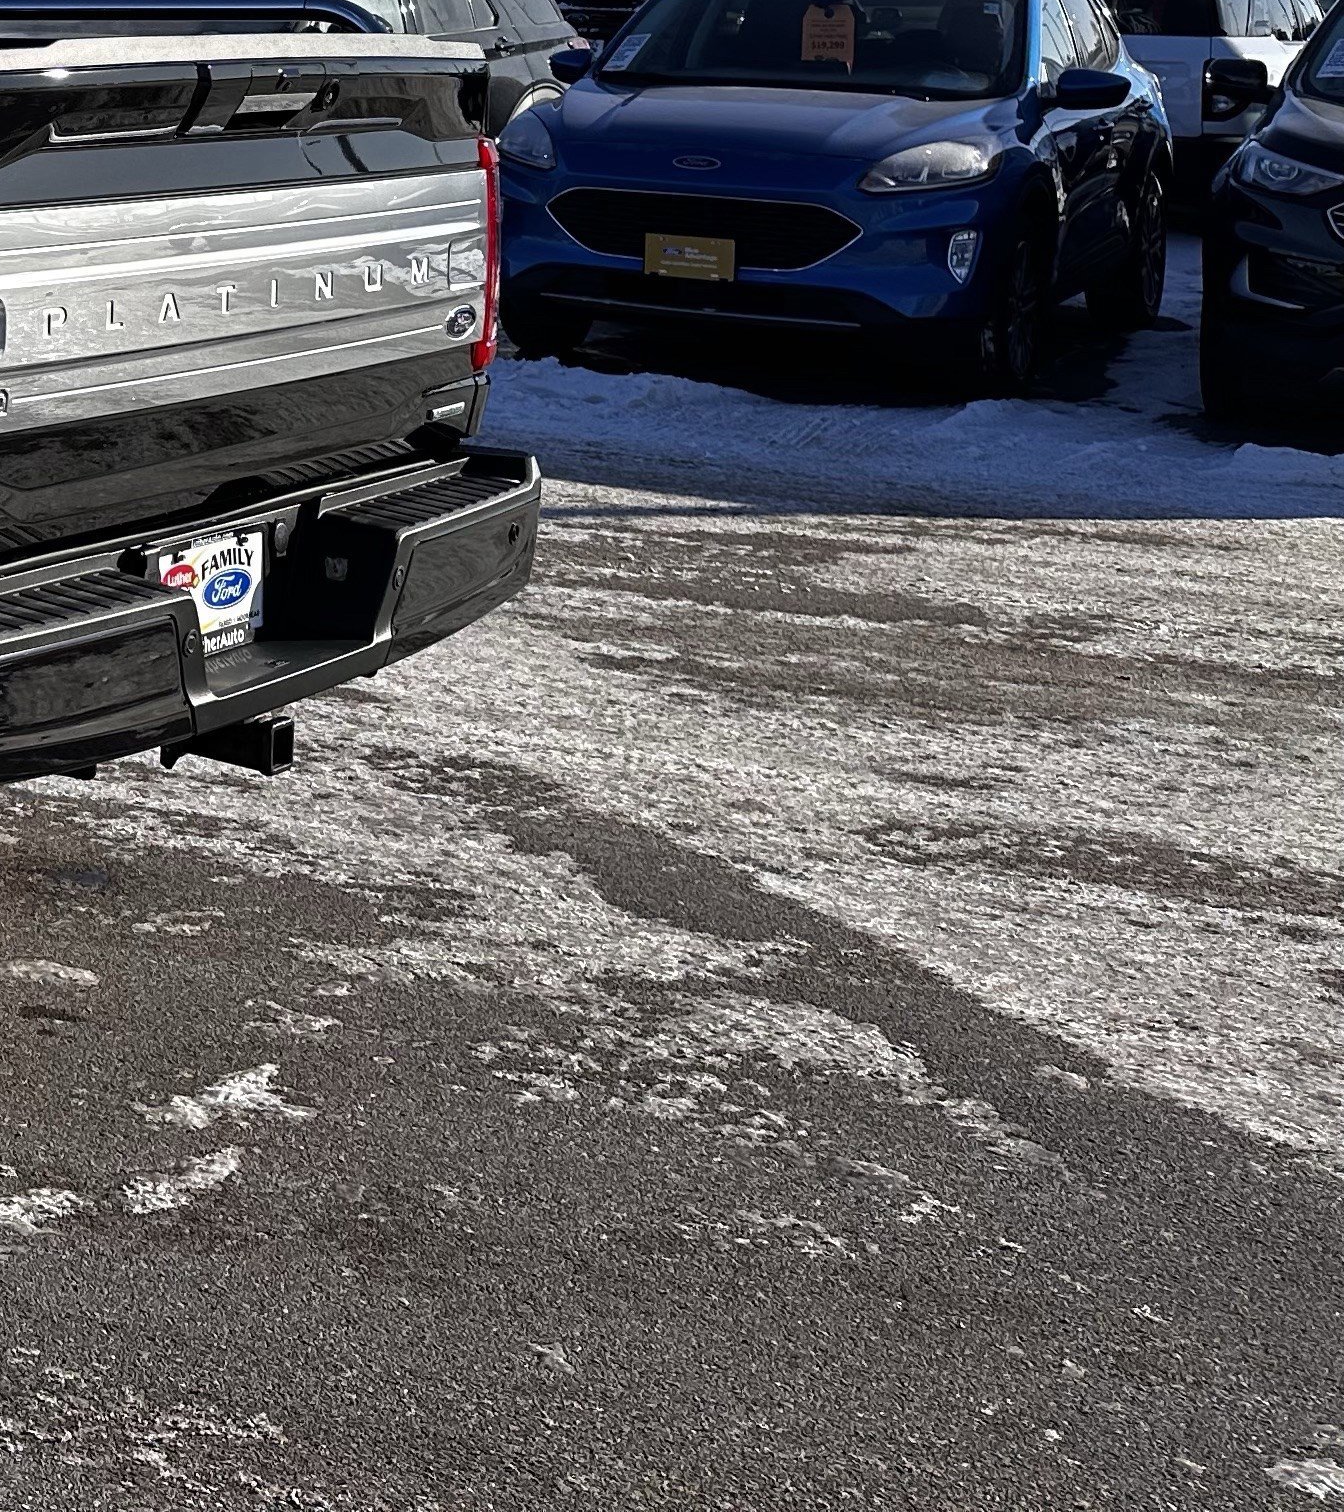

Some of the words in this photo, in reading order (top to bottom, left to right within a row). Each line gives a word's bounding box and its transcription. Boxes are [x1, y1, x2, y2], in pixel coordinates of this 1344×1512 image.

[41, 256, 430, 337] PLATINUM
[167, 570, 193, 587] Luther
[201, 548, 254, 581] FAMILY
[212, 574, 243, 603] Ford
